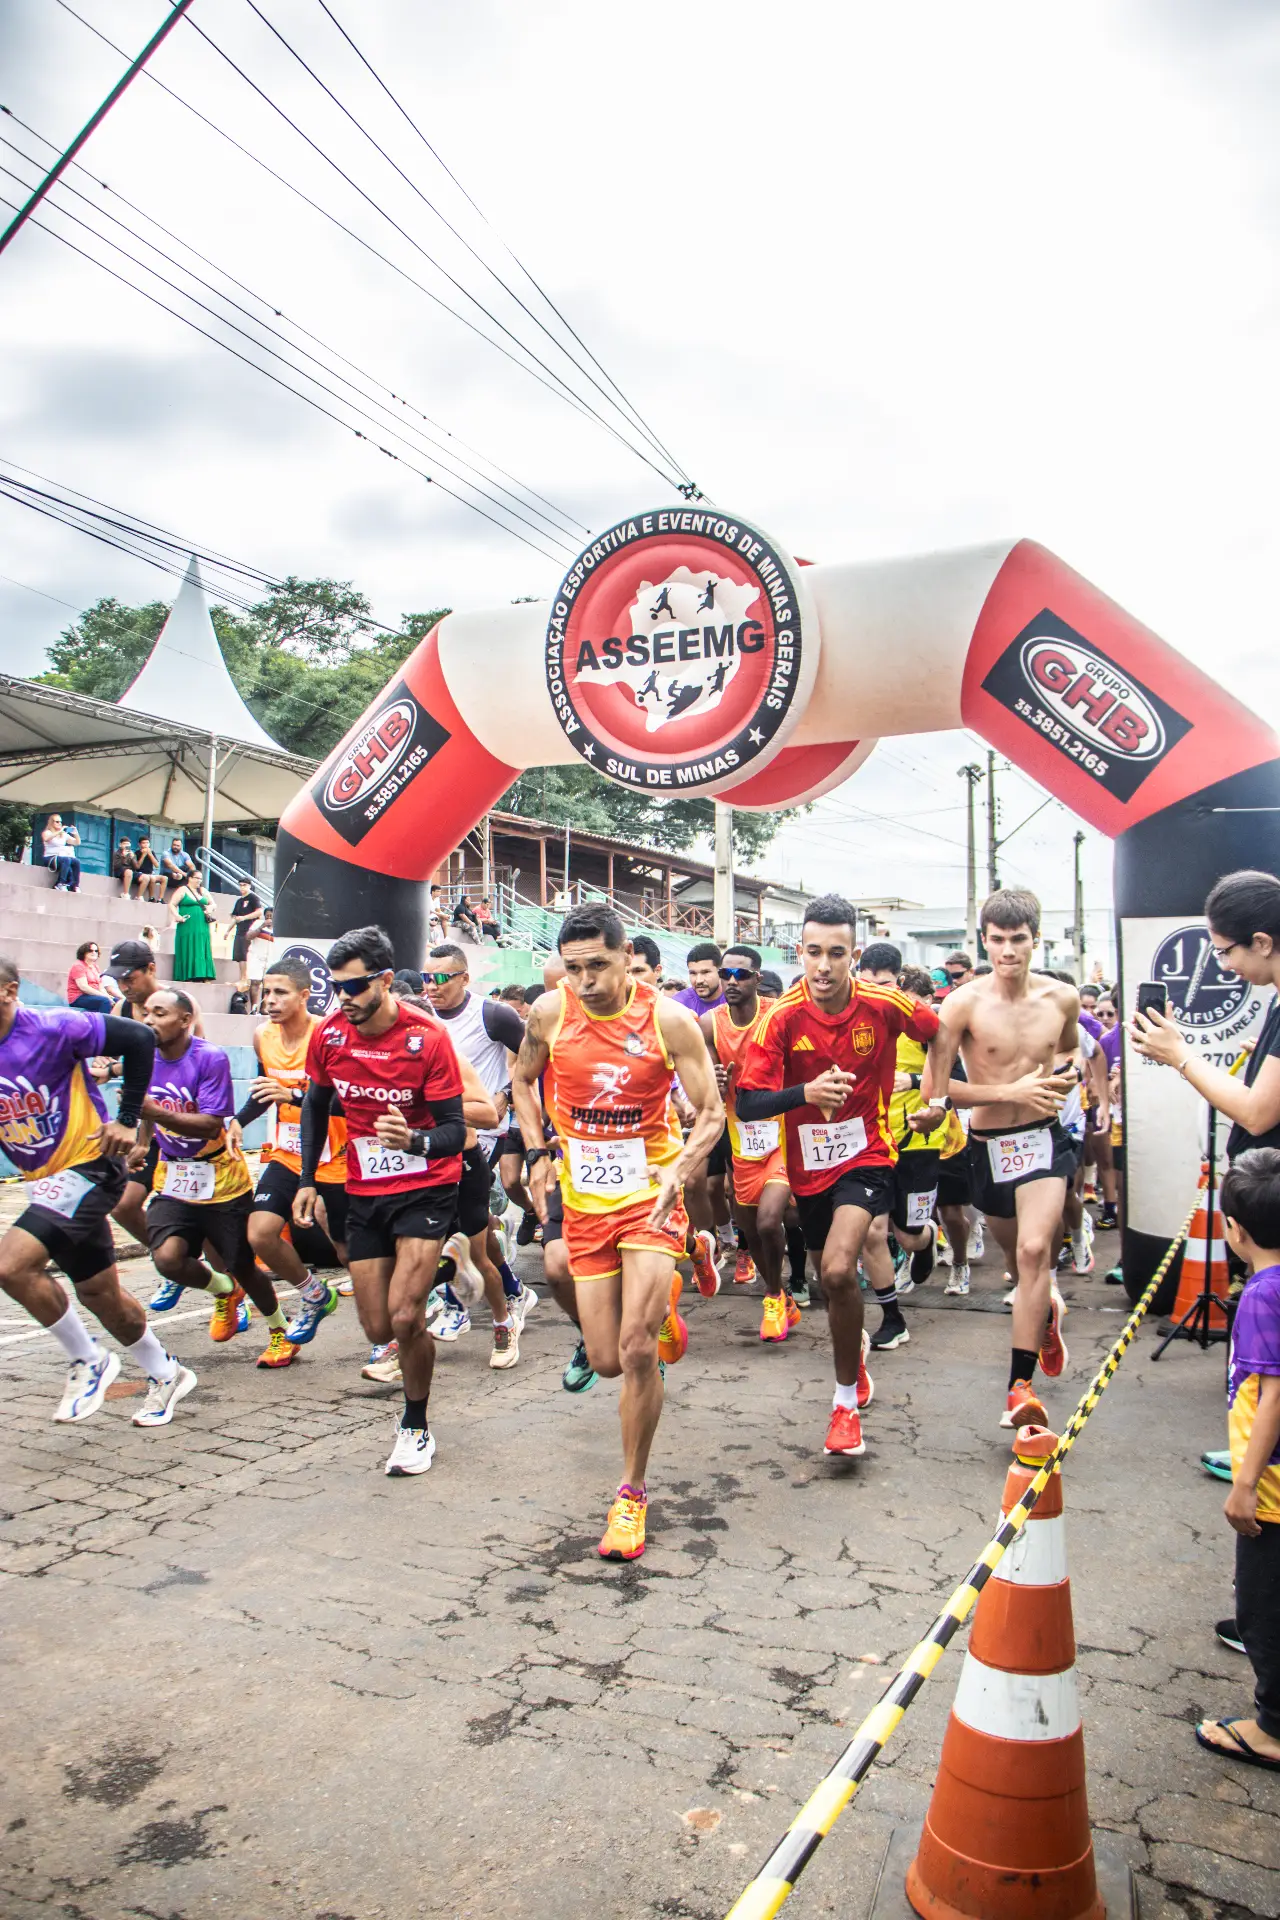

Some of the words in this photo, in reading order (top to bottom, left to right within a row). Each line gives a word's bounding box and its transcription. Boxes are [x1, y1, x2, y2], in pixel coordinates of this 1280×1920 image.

[642, 515, 653, 533] E
[658, 511, 740, 544] EVENTOS
[562, 522, 639, 600] ESPORTIVA
[737, 535, 764, 562] DE
[757, 555, 792, 624] MINAS
[576, 620, 765, 672] ASSEEMG
[547, 601, 581, 735] ASSOCIAÇÃO
[766, 629, 794, 711] GERAIS
[1084, 661, 1131, 700] GRUPO
[1031, 649, 1149, 752] GHB
[347, 726, 376, 761] GRUPO
[1013, 698, 1110, 777] 35.3851.2165
[333, 711, 410, 802] GHB
[606, 757, 641, 784] SUL
[646, 768, 672, 785] DE
[676, 749, 741, 784] MINAS
[364, 744, 429, 821] 35.3851.2165
[1173, 990, 1242, 1024] RAFUSOS
[1200, 1034, 1211, 1045] &
[1214, 1000, 1262, 1042] VAREJO
[349, 1085, 413, 1102] SICOOB
[286, 1140, 302, 1154] 35
[747, 1137, 766, 1151] 164
[812, 1143, 849, 1162] 172
[367, 1155, 405, 1174] 243
[580, 1165, 624, 1184] 223
[1000, 1153, 1035, 1173] 297
[171, 1178, 200, 1194] 274
[915, 1208, 930, 1220] 21
